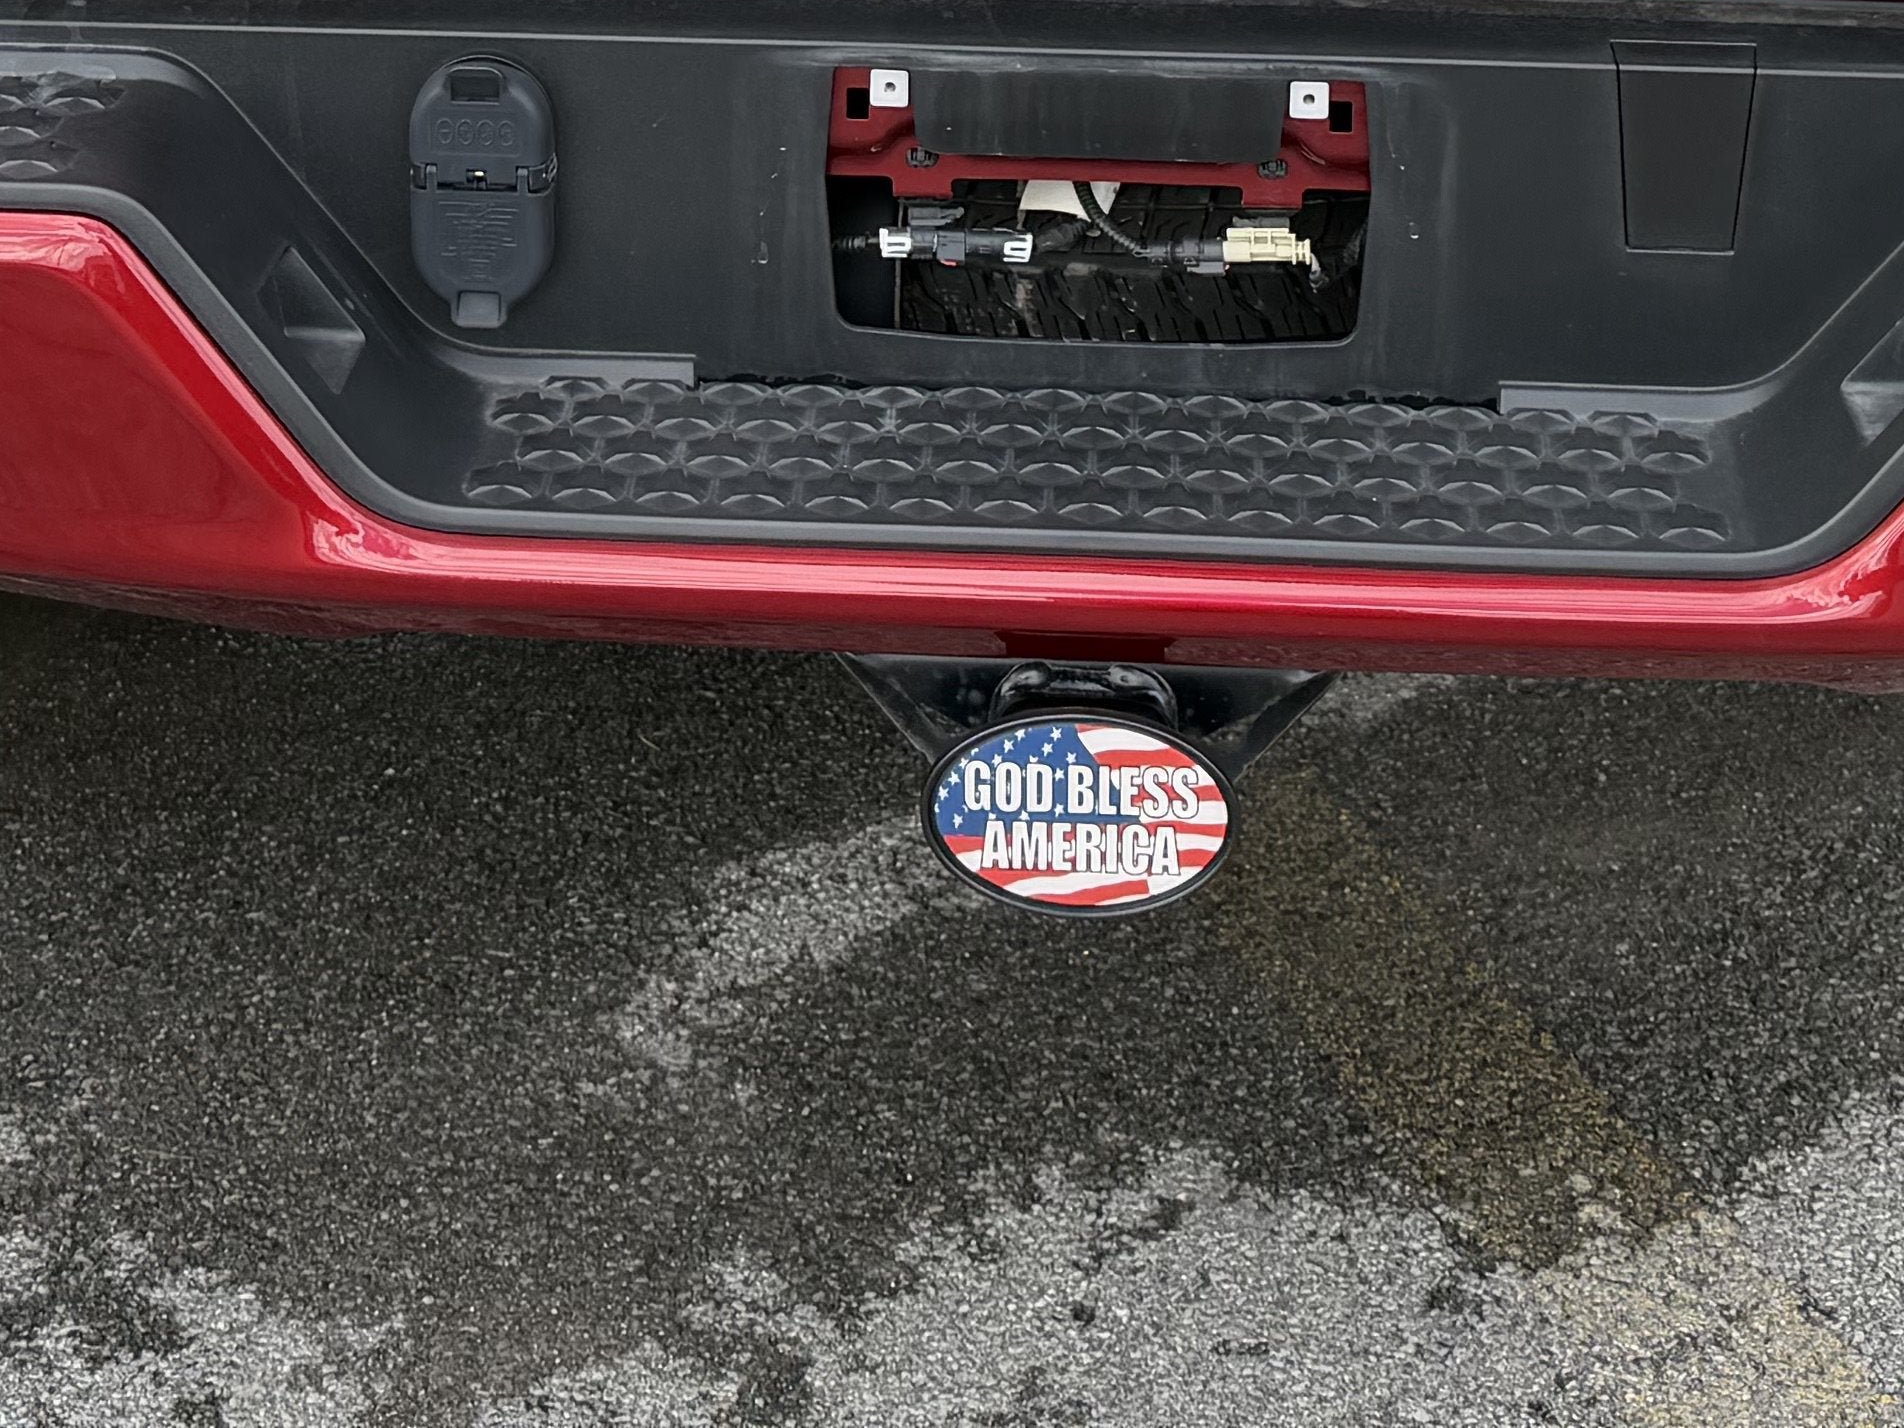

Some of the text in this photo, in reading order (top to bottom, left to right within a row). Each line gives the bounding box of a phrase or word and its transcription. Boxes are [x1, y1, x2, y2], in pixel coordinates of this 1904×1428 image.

[962, 759, 1200, 820] GOD BLESS
[980, 820, 1182, 877] AMERICA
